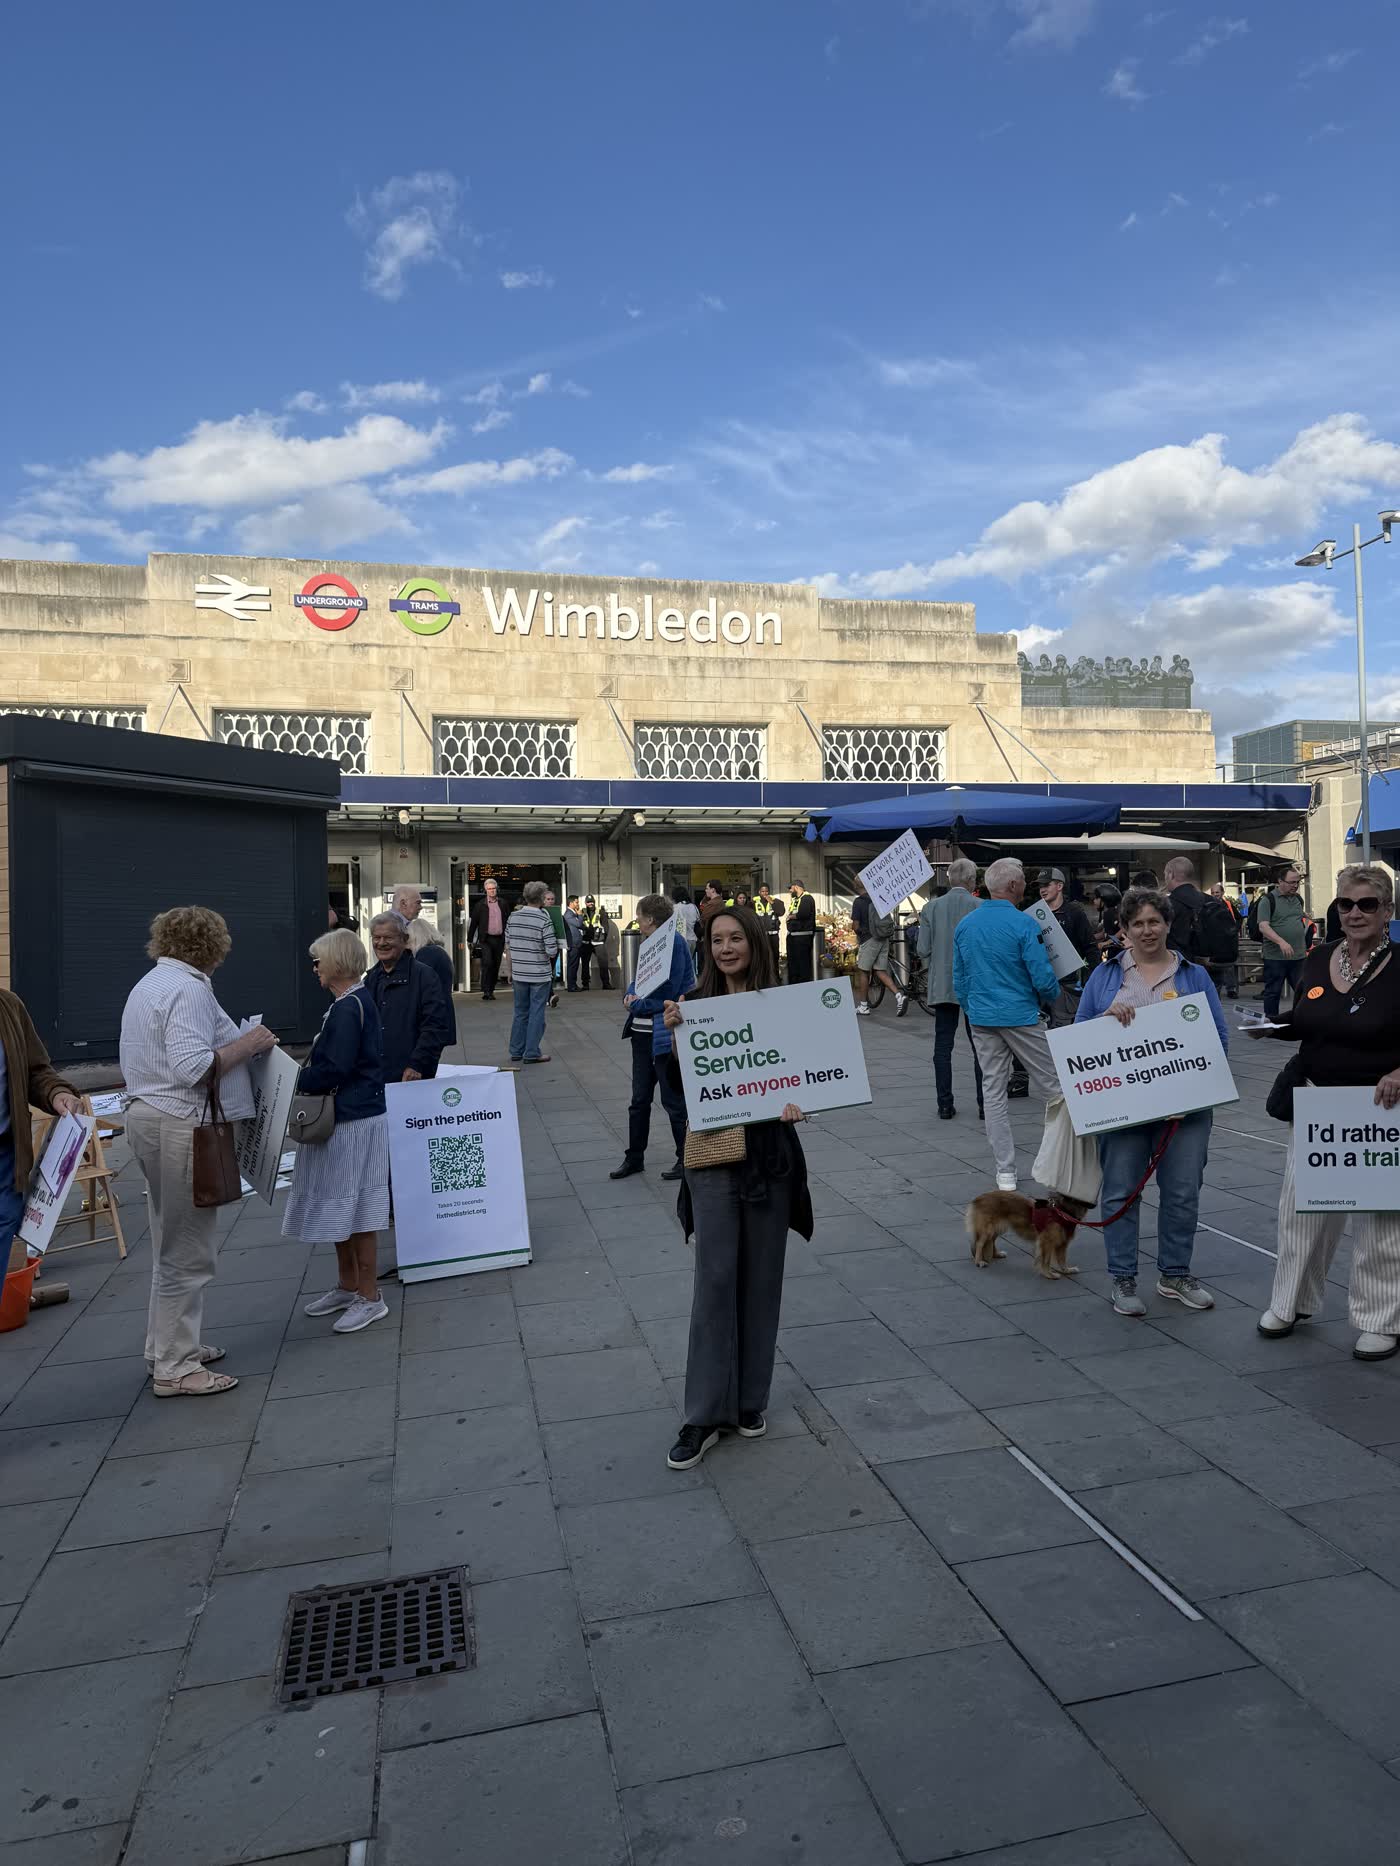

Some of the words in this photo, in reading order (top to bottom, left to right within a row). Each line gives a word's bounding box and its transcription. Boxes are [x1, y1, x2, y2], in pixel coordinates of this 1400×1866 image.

[296, 596, 363, 608] UNDERGROUND
[410, 601, 439, 611] TRAMS
[482, 586, 782, 645] Wimbledon
[866, 853, 894, 880] NETWORK
[895, 839, 910, 856] RAIL
[872, 877, 884, 891] AND
[886, 865, 898, 879] TFL
[900, 848, 917, 866] HAVE
[884, 865, 915, 894] SIGNALLY
[892, 879, 916, 902] FAILED
[699, 1017, 714, 1025] says
[690, 1023, 753, 1051] Good
[694, 1048, 786, 1076] Service.
[1066, 1052, 1112, 1074] New
[1117, 1037, 1185, 1062] trains.
[699, 1084, 733, 1102] Ask
[737, 1075, 801, 1096] anyone
[805, 1067, 849, 1085] here.
[1074, 1076, 1123, 1096] 1980s
[1126, 1055, 1212, 1084] signalling.
[405, 1116, 433, 1130] Sign
[434, 1115, 454, 1126] the
[456, 1109, 502, 1126] petition
[702, 1111, 751, 1124] fixthedistrict.org
[1308, 1124, 1334, 1142] I’d
[249, 1151, 258, 1176] from
[1308, 1152, 1337, 1167] on
[1343, 1152, 1357, 1167] a
[436, 1208, 487, 1219] fixthedistrict.org
